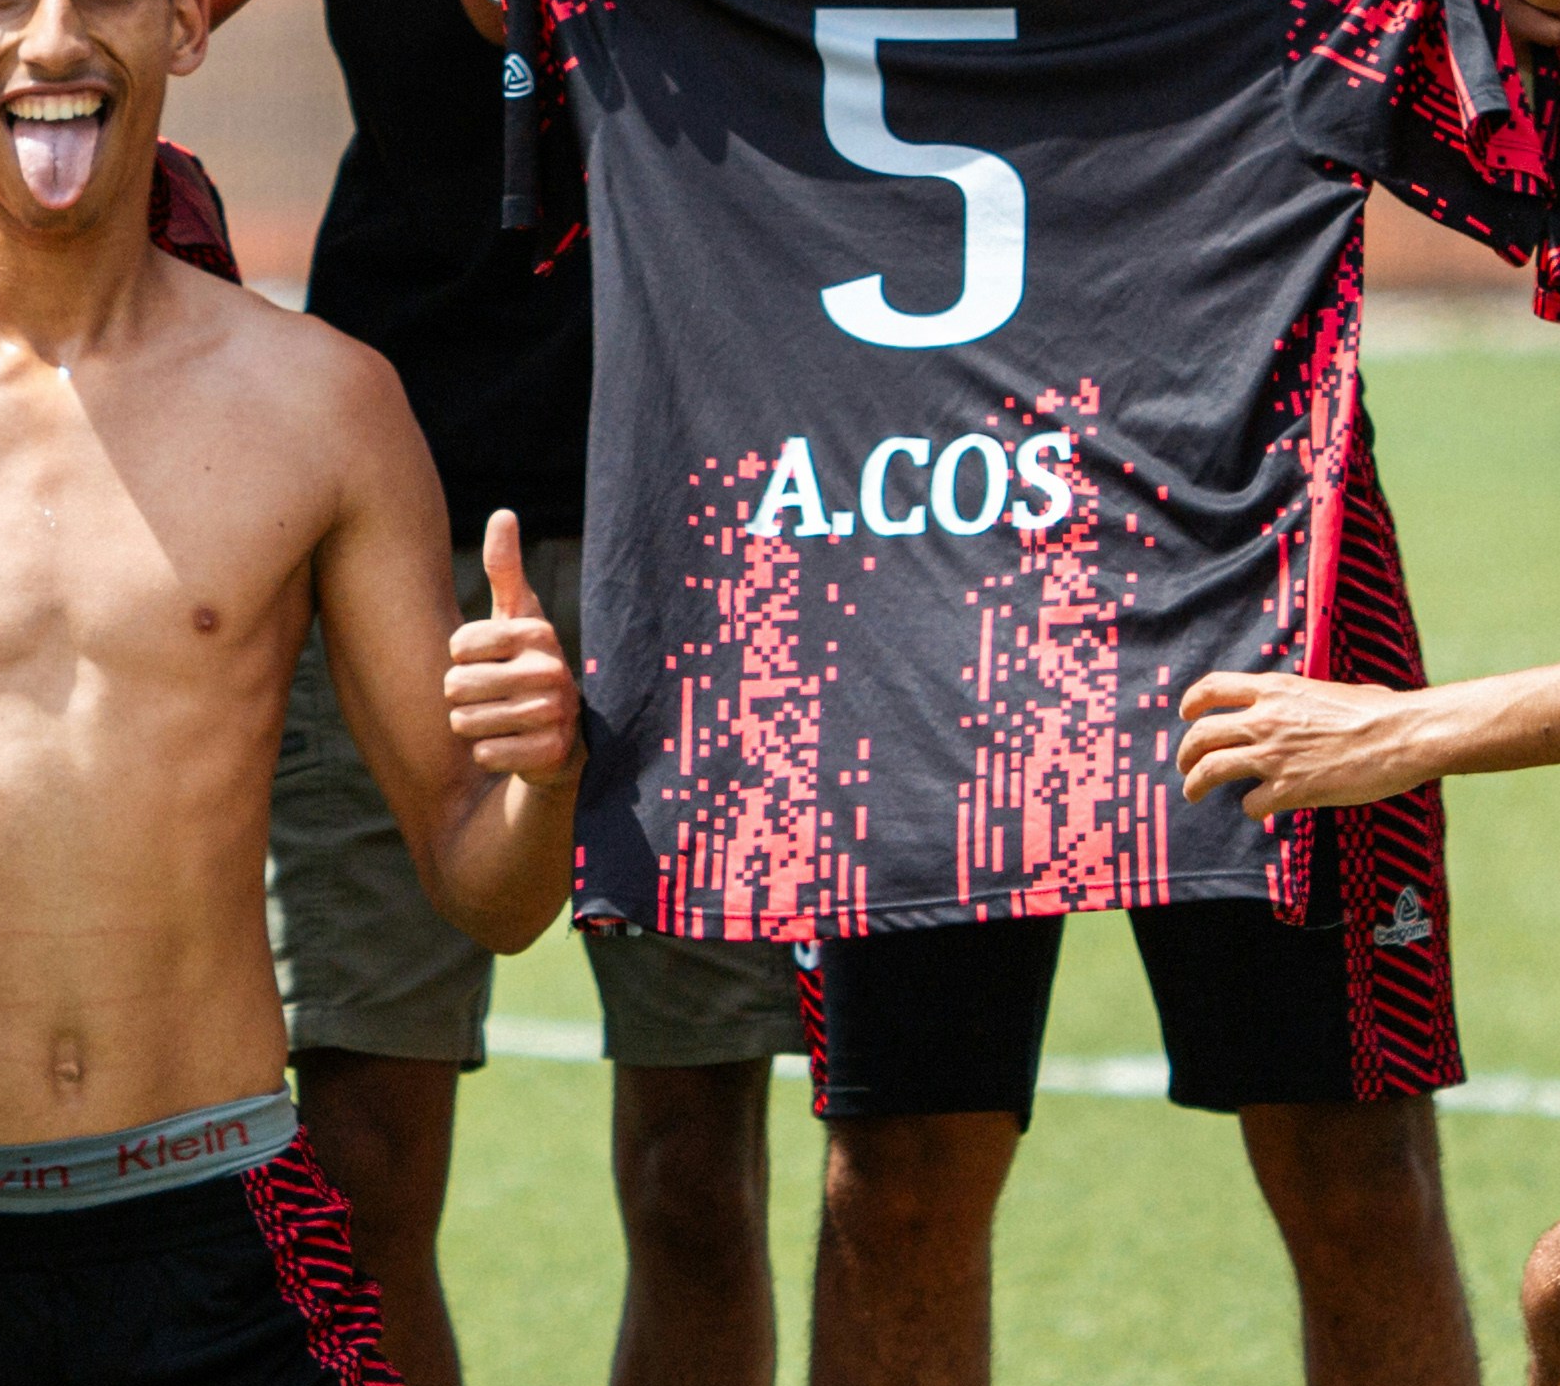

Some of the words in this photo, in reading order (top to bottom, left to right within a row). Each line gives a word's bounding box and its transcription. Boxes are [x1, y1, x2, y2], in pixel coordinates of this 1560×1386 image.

[816, 9, 1024, 347] 5
[745, 432, 1072, 538] A.COS
[116, 1118, 251, 1178] Klein
